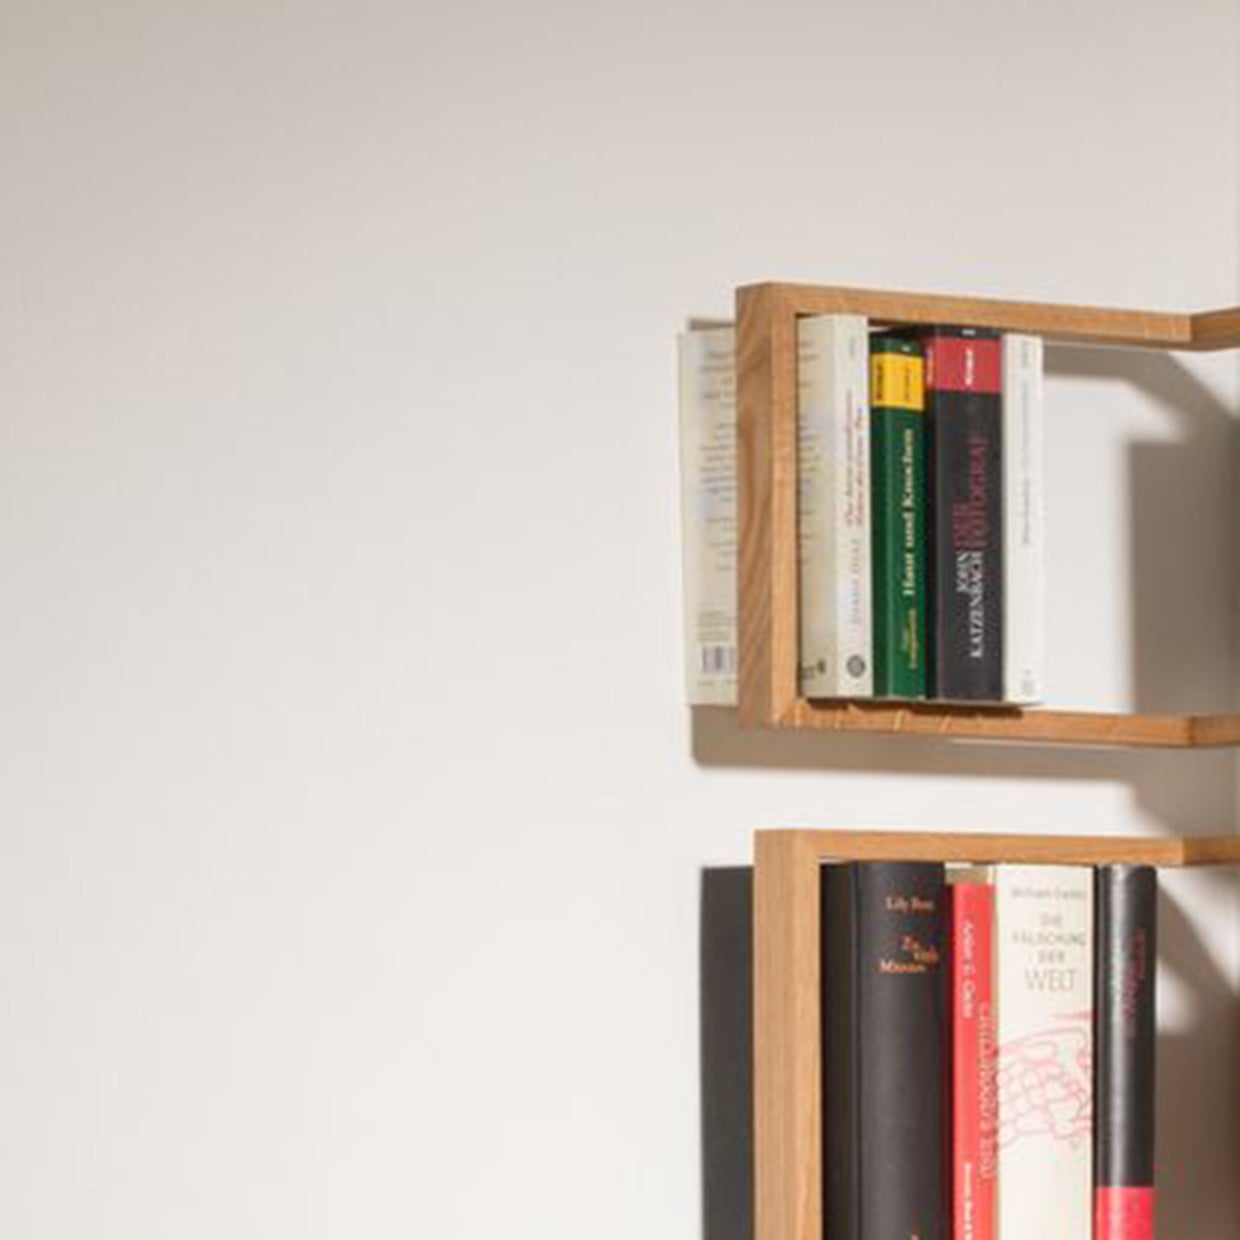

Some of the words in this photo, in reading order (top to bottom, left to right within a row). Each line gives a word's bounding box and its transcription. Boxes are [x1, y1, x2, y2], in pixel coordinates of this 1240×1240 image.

[901, 428, 916, 508] Knochen
[969, 436, 988, 548] FOTOGRAF
[901, 512, 916, 547] und
[901, 553, 917, 595] Haut
[956, 551, 968, 593] JOHN
[969, 551, 984, 659] KATZENBACH
[1025, 968, 1076, 991] WELT
